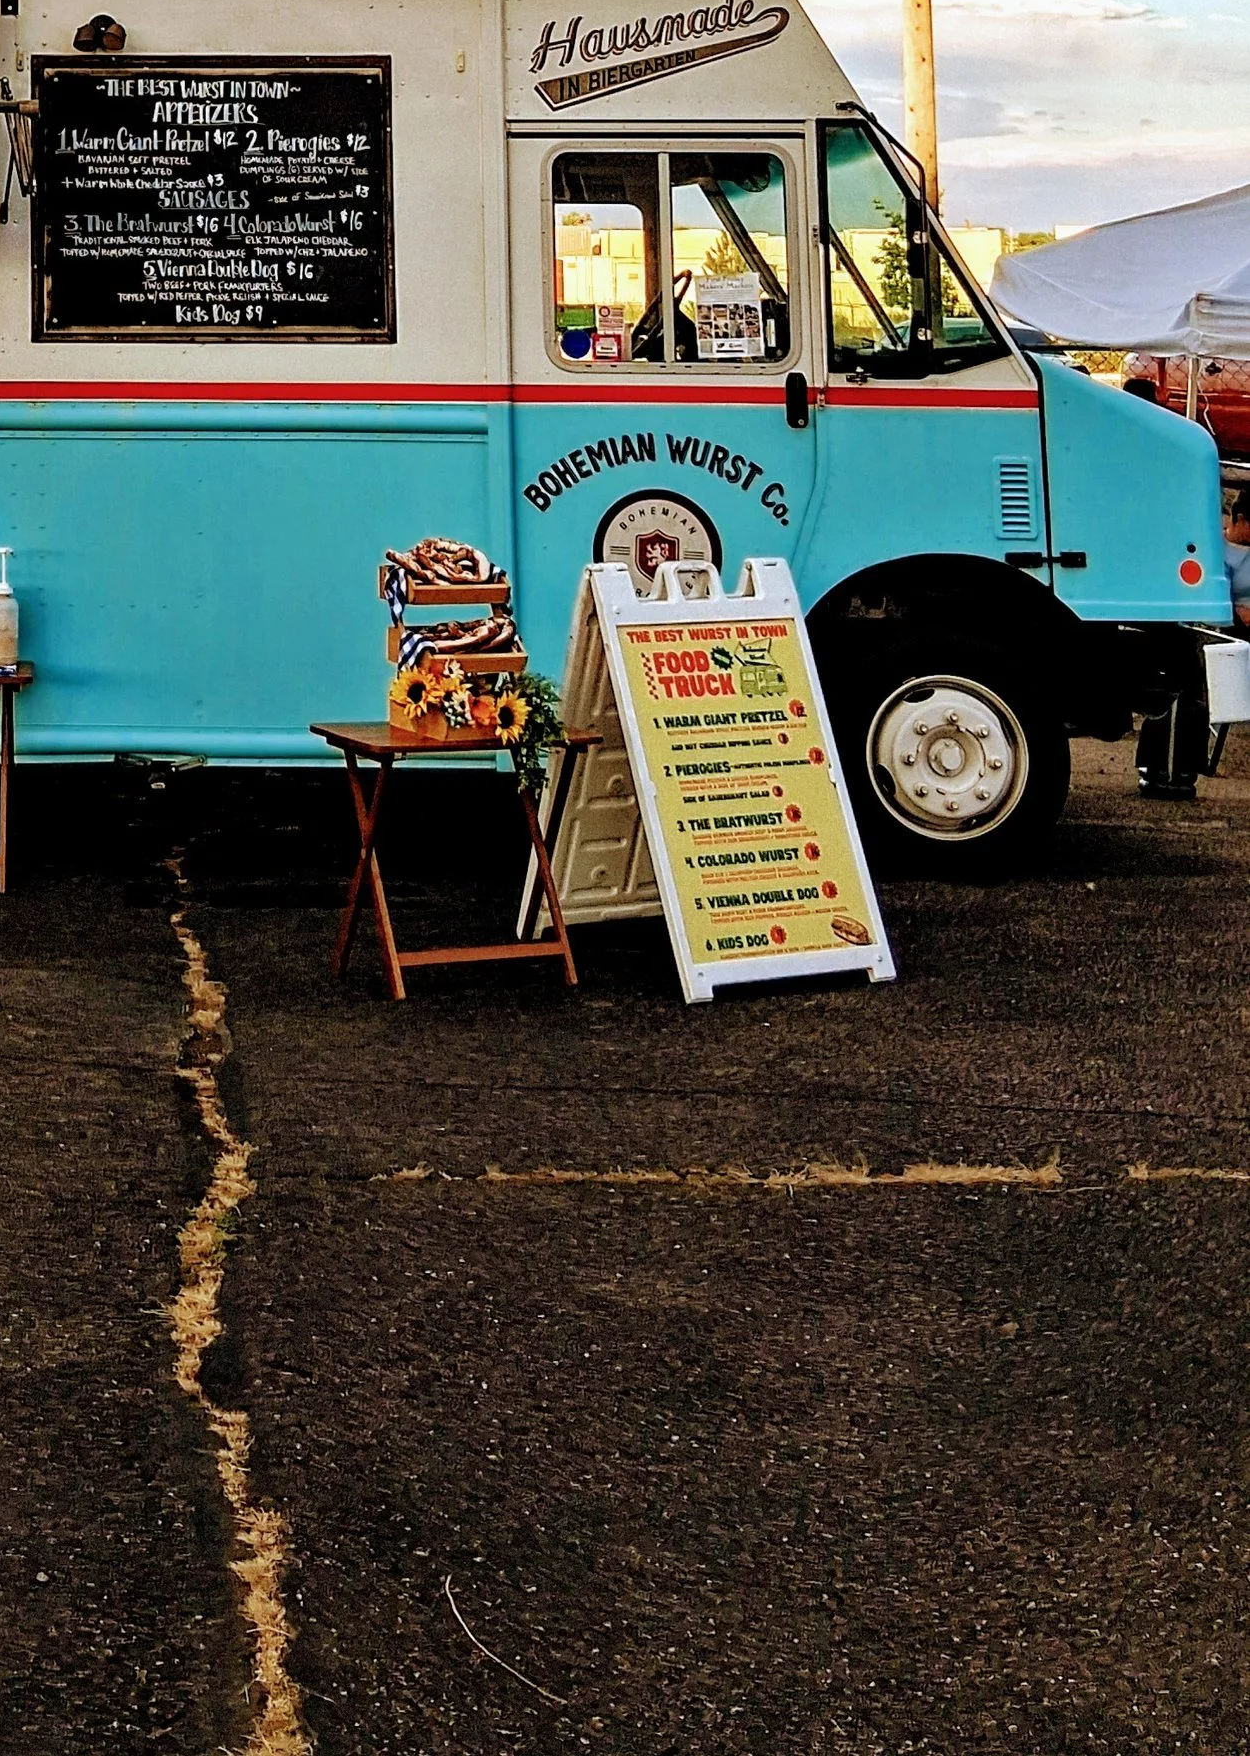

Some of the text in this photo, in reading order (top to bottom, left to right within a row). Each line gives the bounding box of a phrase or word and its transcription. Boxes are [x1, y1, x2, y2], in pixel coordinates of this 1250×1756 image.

[558, 49, 698, 101] IN BIERGARTEN
[138, 79, 178, 97] BEST
[180, 80, 230, 98] WURST
[230, 80, 246, 98] IN
[152, 100, 259, 125] APPETIZERS
[56, 126, 239, 153] 1. Warm Giant Pretzel $12
[245, 128, 371, 159] 2. Pierogies $12
[77, 153, 125, 164] BAVARIAN
[152, 155, 192, 166] PRETZEL
[140, 165, 173, 176] SALTED
[75, 177, 108, 189] Warm
[207, 173, 225, 188] $3
[355, 184, 370, 198] $3
[157, 189, 250, 209] SAUSAGES
[63, 212, 219, 234] 3. The Bratwurst $16
[223, 208, 364, 235] 4. Colorado Wurst $16
[143, 259, 314, 281] 5. Vienna Double Dog $16
[175, 303, 263, 325] Kids Dog $9
[523, 432, 791, 527] BOHEMIAN WURST Co.
[618, 506, 698, 535] BOHEMIAN
[626, 624, 788, 644] THE BEST WURST IN TOWN
[652, 650, 710, 675] FOOD
[658, 673, 738, 699] TRUCK
[663, 714, 701, 729] WARM
[704, 712, 737, 727] GIANT
[740, 709, 789, 725] PRETZEL
[675, 760, 732, 777] PIEROGIES
[688, 817, 711, 832] THE
[713, 811, 783, 829] BRATWURST
[697, 850, 757, 868] COLORADO
[759, 847, 799, 863] WURST
[707, 893, 751, 910] VIENNA
[752, 889, 795, 904] DOUBLE
[796, 886, 820, 901] DOG
[716, 935, 744, 951] KIDS
[745, 932, 770, 949] DOG
